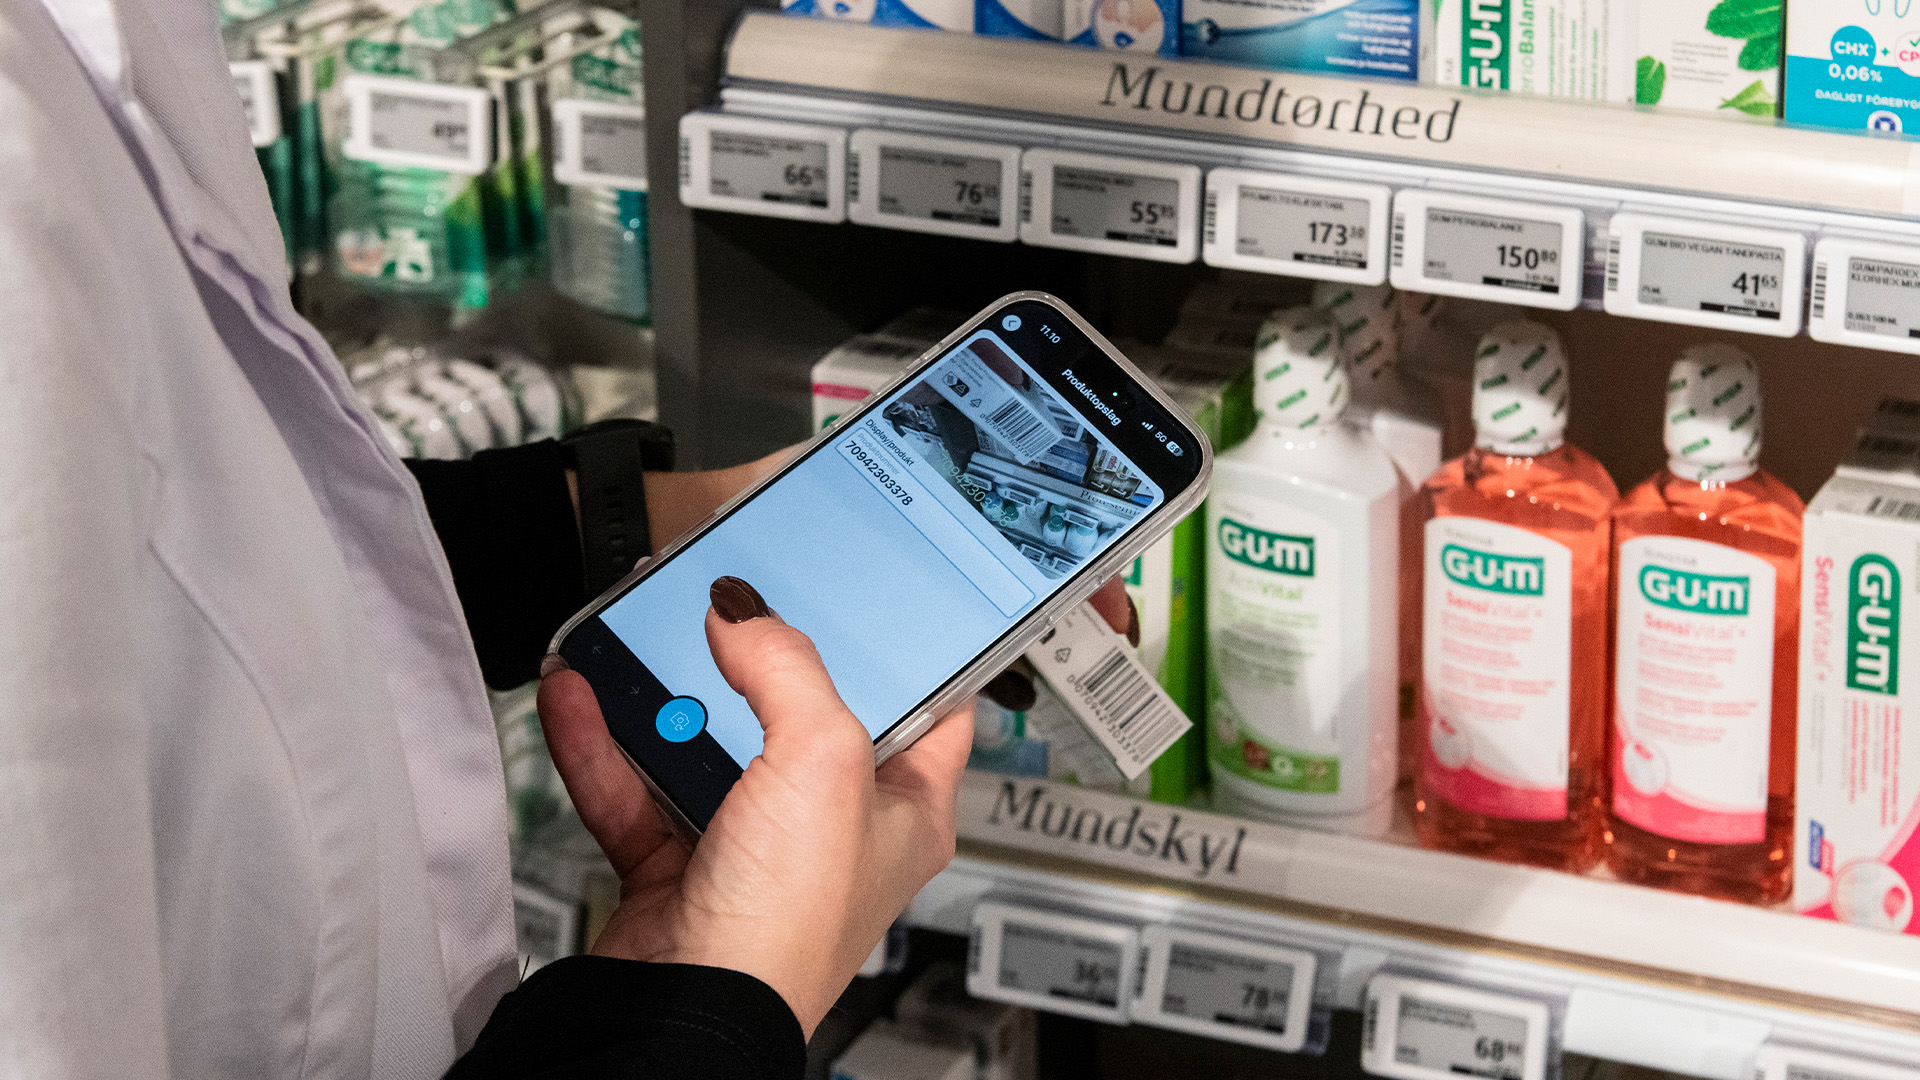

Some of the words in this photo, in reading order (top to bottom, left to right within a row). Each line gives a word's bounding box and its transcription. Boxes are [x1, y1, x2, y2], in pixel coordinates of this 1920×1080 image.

[1829, 63, 1882, 82] 0,06%
[1899, 50, 1920, 62] CP
[1102, 62, 1461, 143] Mundtørhed
[1815, 89, 1862, 103] DAGLIGT
[1866, 94, 1920, 110] FÖREBYG
[1039, 324, 1061, 344] 11.10
[1061, 368, 1122, 427] Produktopslag
[856, 432, 901, 476] Produktnummer
[865, 418, 915, 467] Display/produkt
[1154, 431, 1167, 443] 5G
[844, 440, 914, 506] 70942303378
[987, 780, 1247, 878] Mundskyl
